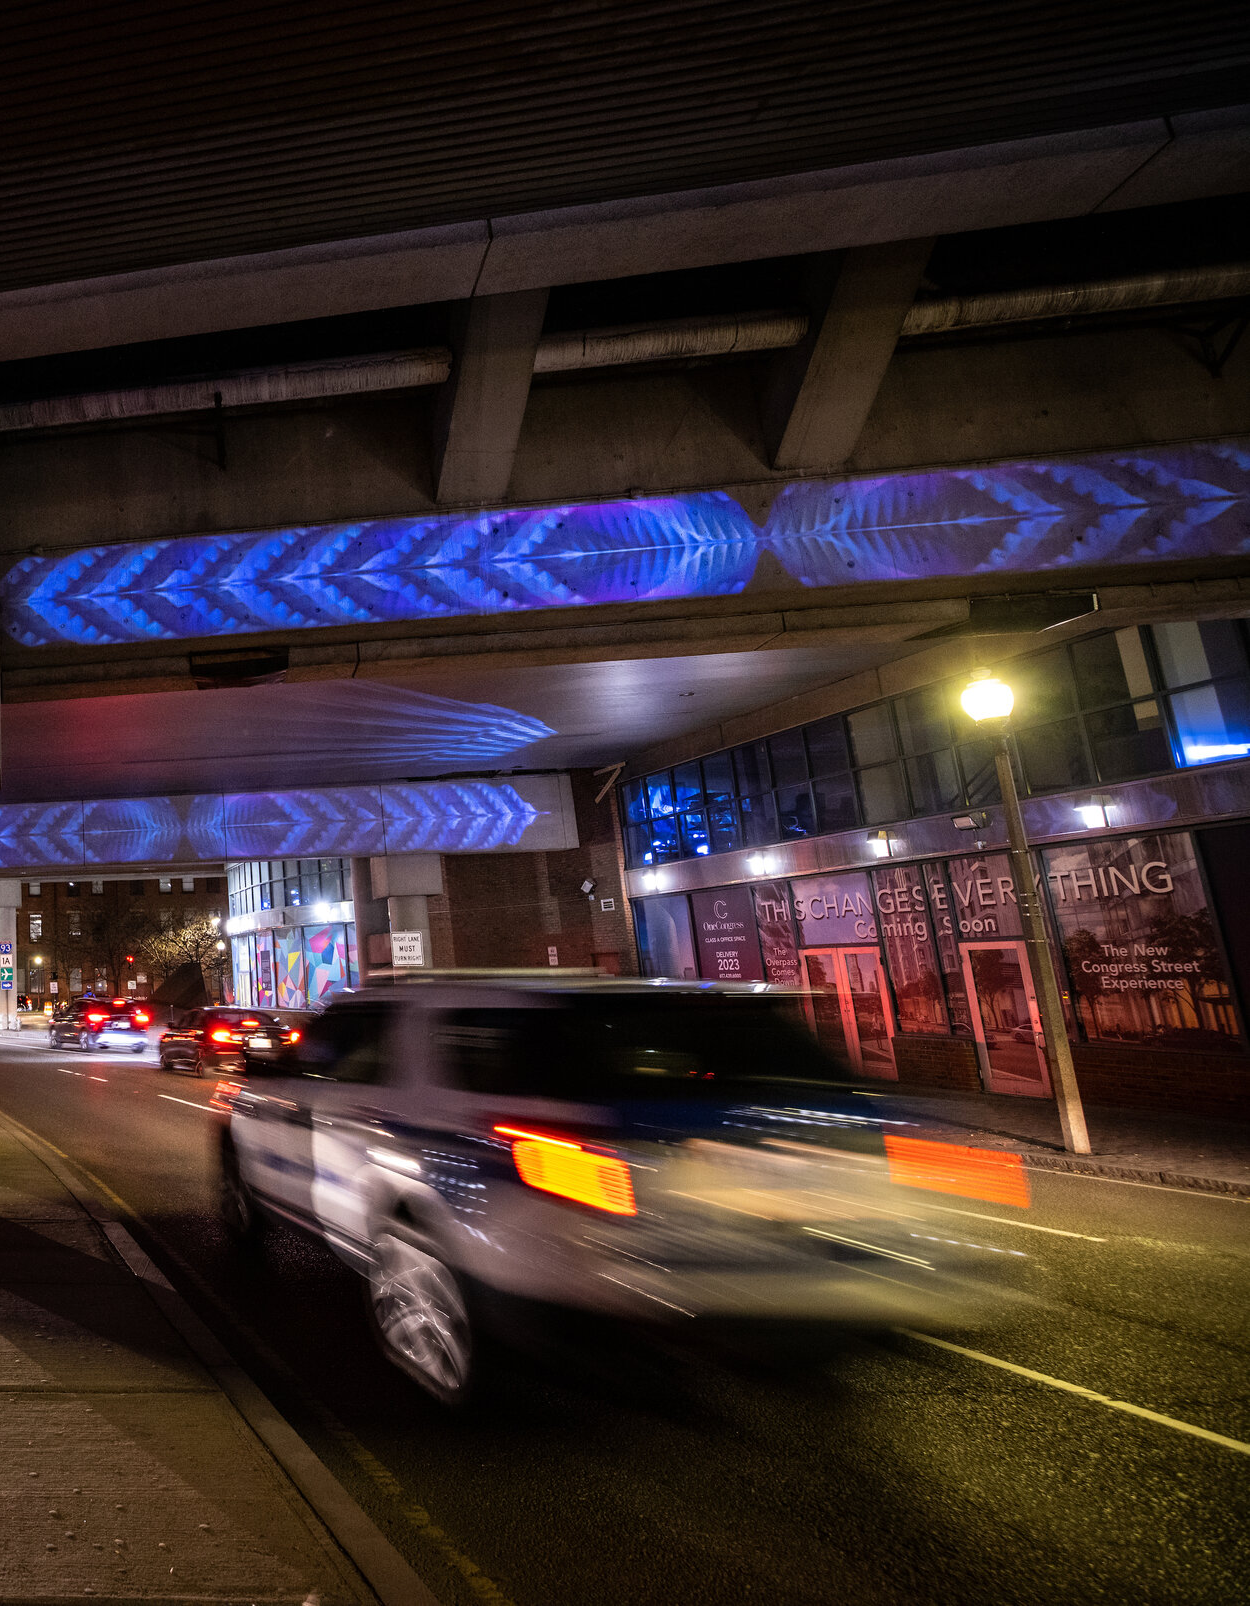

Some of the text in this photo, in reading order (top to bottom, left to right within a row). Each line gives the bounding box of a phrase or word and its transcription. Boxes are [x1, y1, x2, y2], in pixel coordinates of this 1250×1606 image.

[760, 900, 807, 923] THIS
[809, 885, 926, 920] CHANGES
[854, 916, 997, 942] Coming Soon
[0, 943, 10, 952] 93
[772, 947, 787, 956] The
[1100, 944, 1168, 957] The New
[2, 957, 10, 965] 1A
[718, 959, 740, 970] 2023
[765, 958, 798, 968] Overpass
[772, 968, 795, 976] Comes
[1081, 959, 1200, 977] Congress Street
[1101, 976, 1184, 992] Experience
